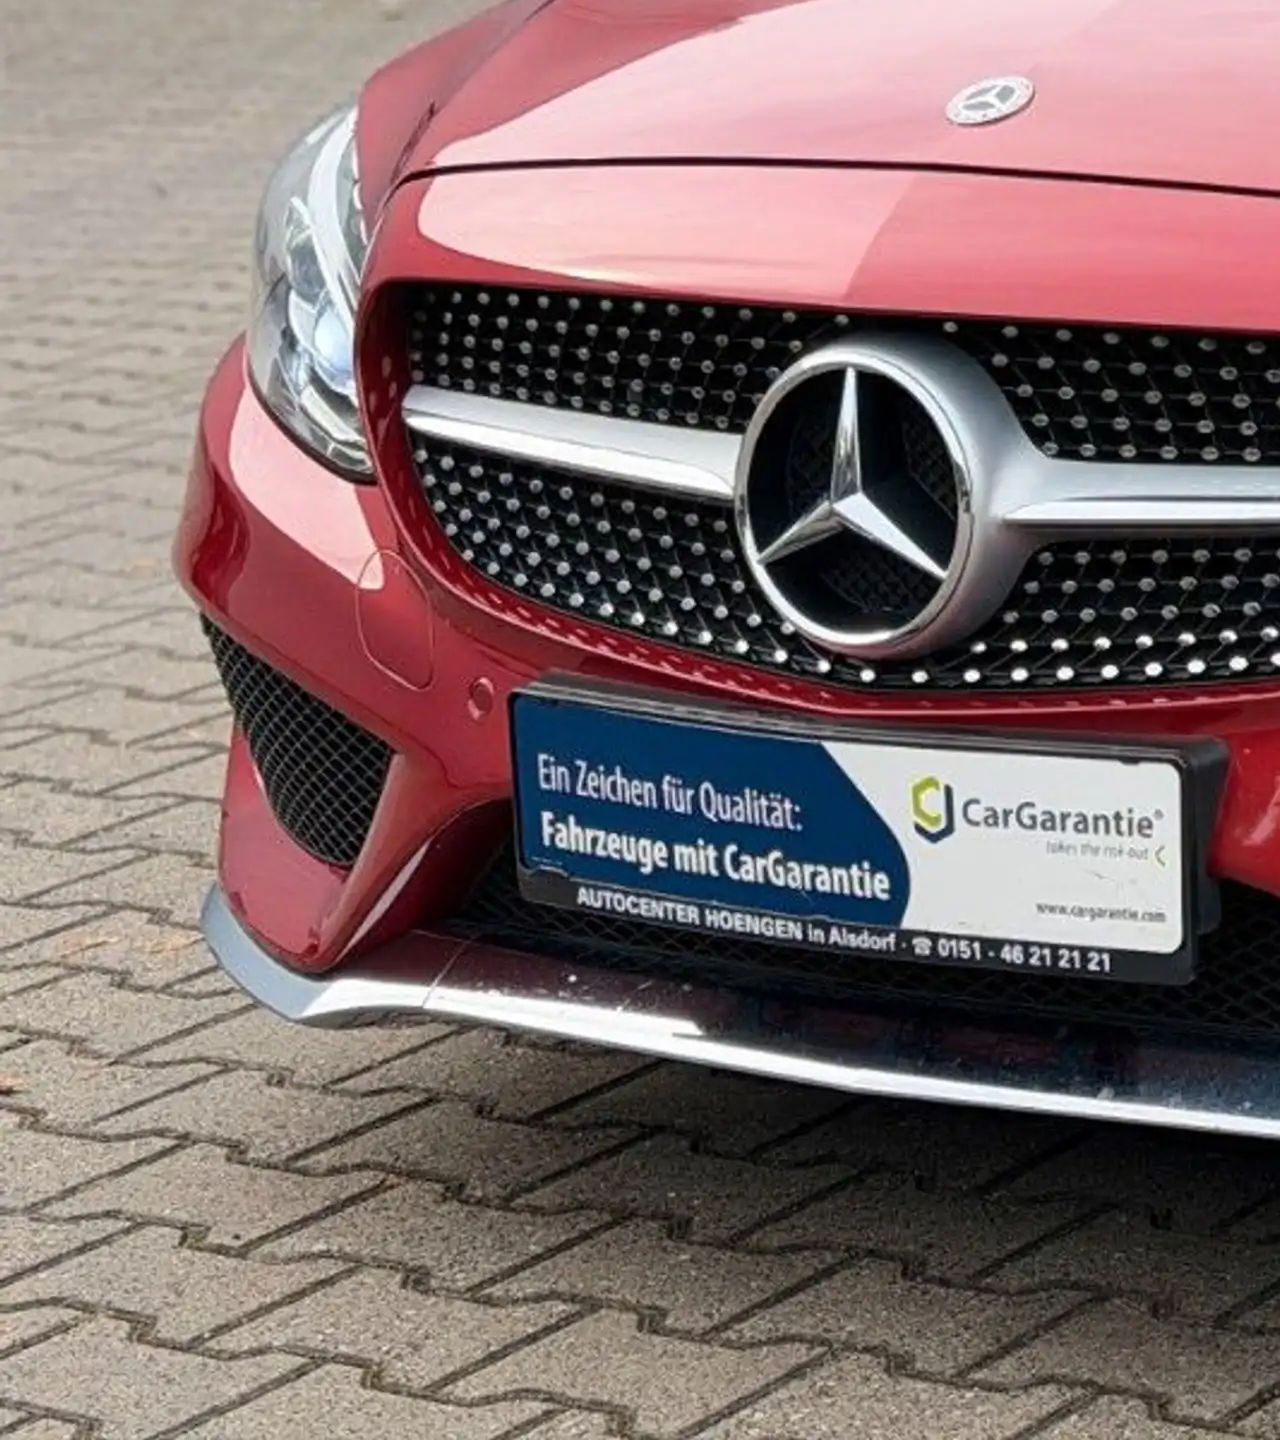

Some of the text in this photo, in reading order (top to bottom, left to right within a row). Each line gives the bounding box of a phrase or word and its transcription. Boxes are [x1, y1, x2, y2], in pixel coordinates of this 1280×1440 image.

[537, 753, 803, 832] Ein Zeichen für Qualität:
[541, 811, 891, 901] Fahrzeuge mit CarGarantie
[576, 887, 700, 926] AUTOCENTER
[705, 909, 803, 941] HOENGEN
[808, 924, 825, 944] in
[829, 926, 896, 951] Alsdorf
[937, 938, 981, 960] 0151
[1000, 943, 1025, 964] 46
[1029, 946, 1052, 967] 21
[1058, 949, 1081, 969] 21
[1087, 951, 1111, 973] 21
[1036, 903, 1167, 923] www.cargarantie.com
